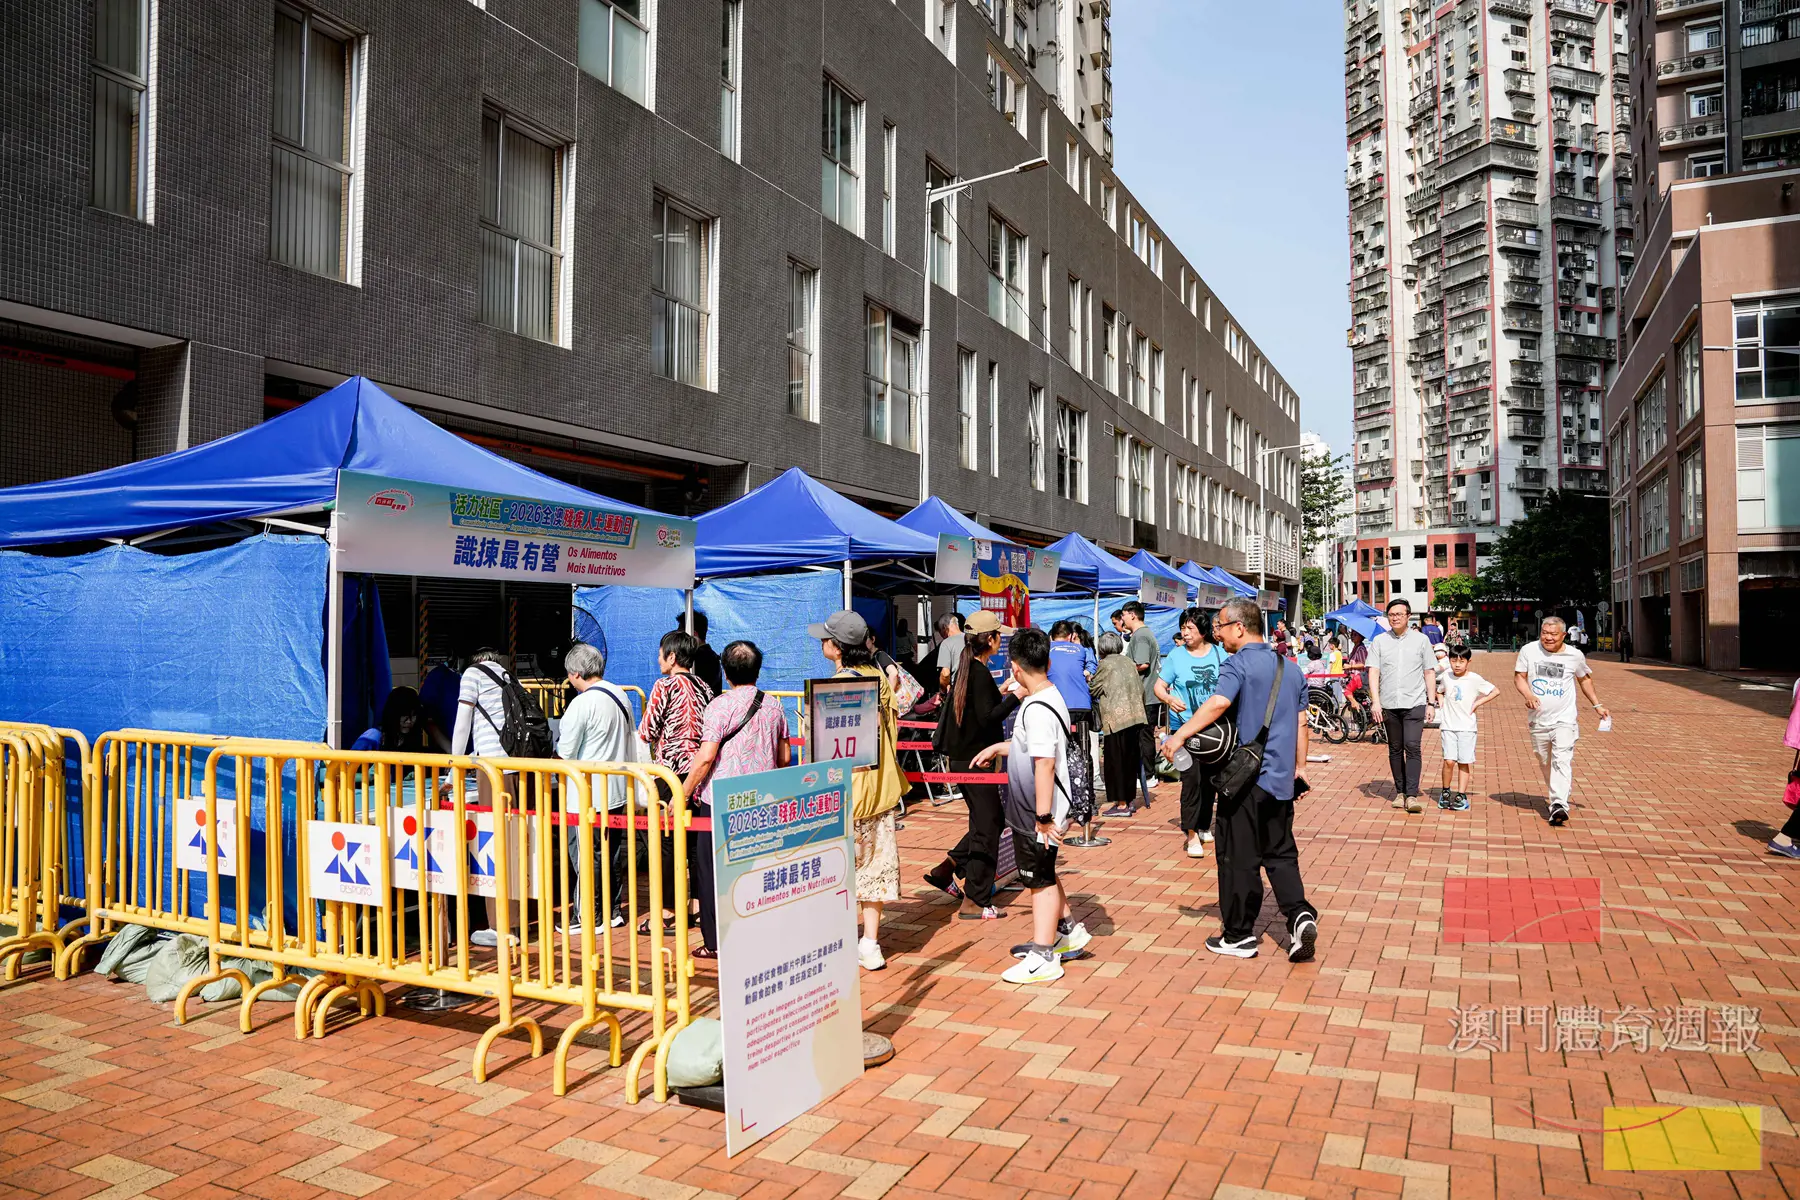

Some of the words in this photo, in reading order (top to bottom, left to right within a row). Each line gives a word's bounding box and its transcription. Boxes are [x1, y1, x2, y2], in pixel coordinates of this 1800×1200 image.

[453, 535, 561, 573] 識揀最有營
[566, 562, 586, 574] Mais
[587, 563, 626, 577] Nutritivos
[567, 546, 578, 558] Os
[579, 547, 618, 561] Alimentos
[1531, 678, 1565, 698] Snap
[831, 736, 857, 760] 入口
[931, 774, 986, 782] www.sport.gov.mo
[728, 791, 841, 836] 2026全澳殘疾人士運動日
[763, 856, 822, 893] 識揀最有營
[745, 901, 755, 911] Os
[757, 890, 790, 907] Alimentos
[791, 885, 807, 896] Mais
[807, 875, 837, 890] Nutritivos
[746, 1018, 750, 1026] A
[751, 1012, 767, 1026] partir
[768, 1008, 775, 1016] de
[776, 998, 796, 1012] imagens
[797, 995, 803, 1003] de
[746, 1016, 782, 1039] participantes
[782, 1002, 812, 1020] seleccionam
[829, 988, 840, 997] mais
[746, 1030, 775, 1048] adequados
[776, 1024, 788, 1036] para
[811, 1006, 824, 1017] antes
[830, 999, 837, 1007] um
[747, 1047, 763, 1060] treino
[764, 1033, 792, 1051] desportivo
[796, 1021, 816, 1035] colocam
[822, 1008, 840, 1022] mesmos
[747, 1061, 759, 1072] num
[760, 1052, 774, 1064] local
